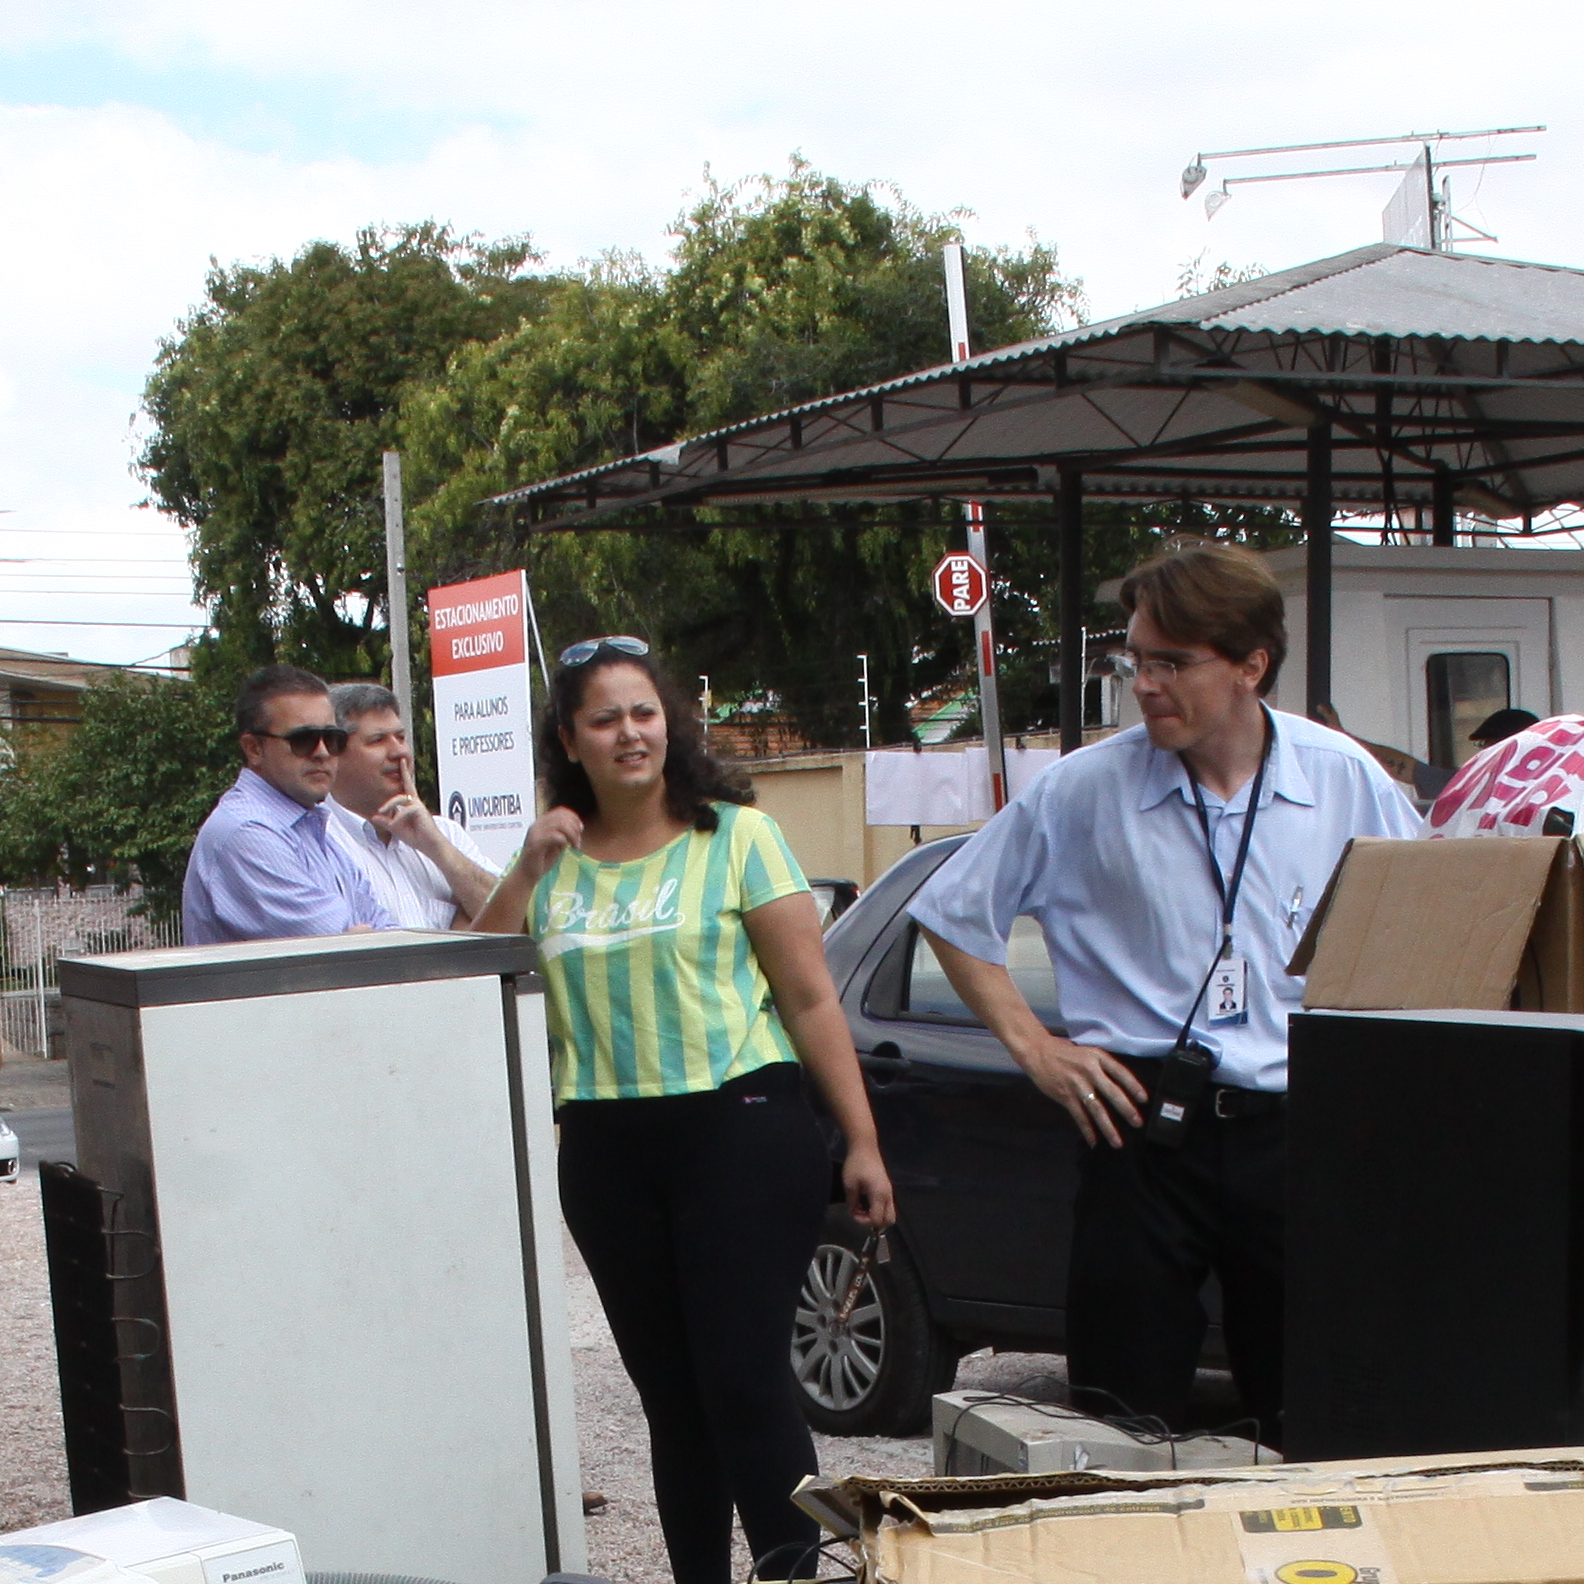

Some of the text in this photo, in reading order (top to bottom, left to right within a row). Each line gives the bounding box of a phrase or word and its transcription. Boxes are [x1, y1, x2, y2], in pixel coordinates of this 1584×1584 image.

[951, 560, 971, 611] PARE
[434, 594, 518, 630] ESTACIONAMENTO
[452, 631, 504, 659] EXCLUSIVO
[454, 696, 508, 721] PARA ALUNOS
[452, 731, 514, 756] E PROFESSORES
[468, 794, 522, 818] UNICURITIBA
[539, 878, 678, 934] Brasil
[222, 1562, 285, 1583] Panasonic
